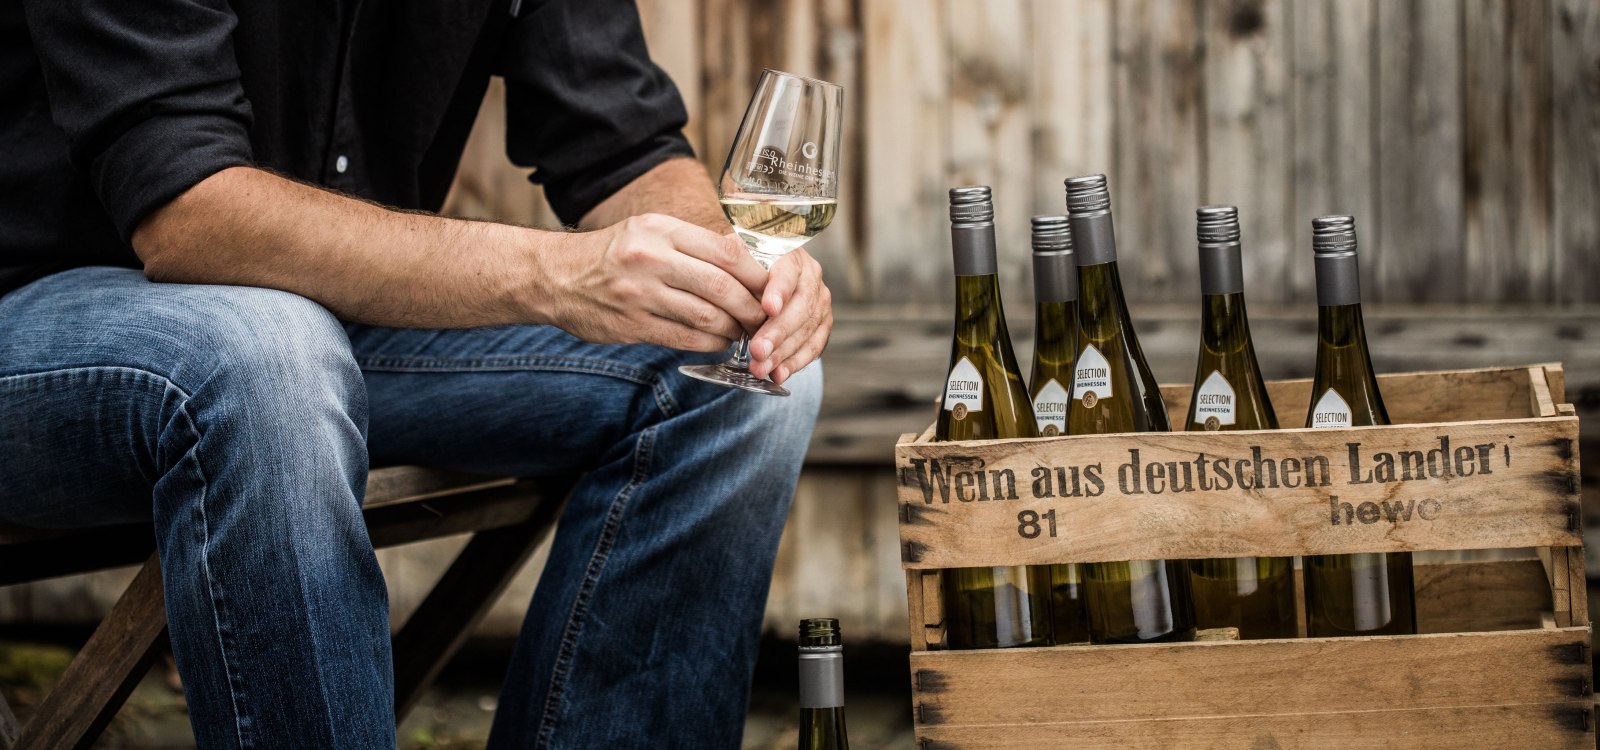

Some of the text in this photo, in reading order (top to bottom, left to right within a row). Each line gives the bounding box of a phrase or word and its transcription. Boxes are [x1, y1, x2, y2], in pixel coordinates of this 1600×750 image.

[1077, 368, 1107, 380] SELECTION
[949, 380, 979, 392] SELECTION
[1076, 381, 1107, 389] RHEINHESSEN
[1200, 394, 1232, 406] SELECTION
[1315, 412, 1348, 424] SELECTION
[909, 457, 1020, 505] Wein
[1030, 461, 1105, 499] aus
[1117, 445, 1331, 495] deutschen
[1017, 508, 1058, 539] 81
